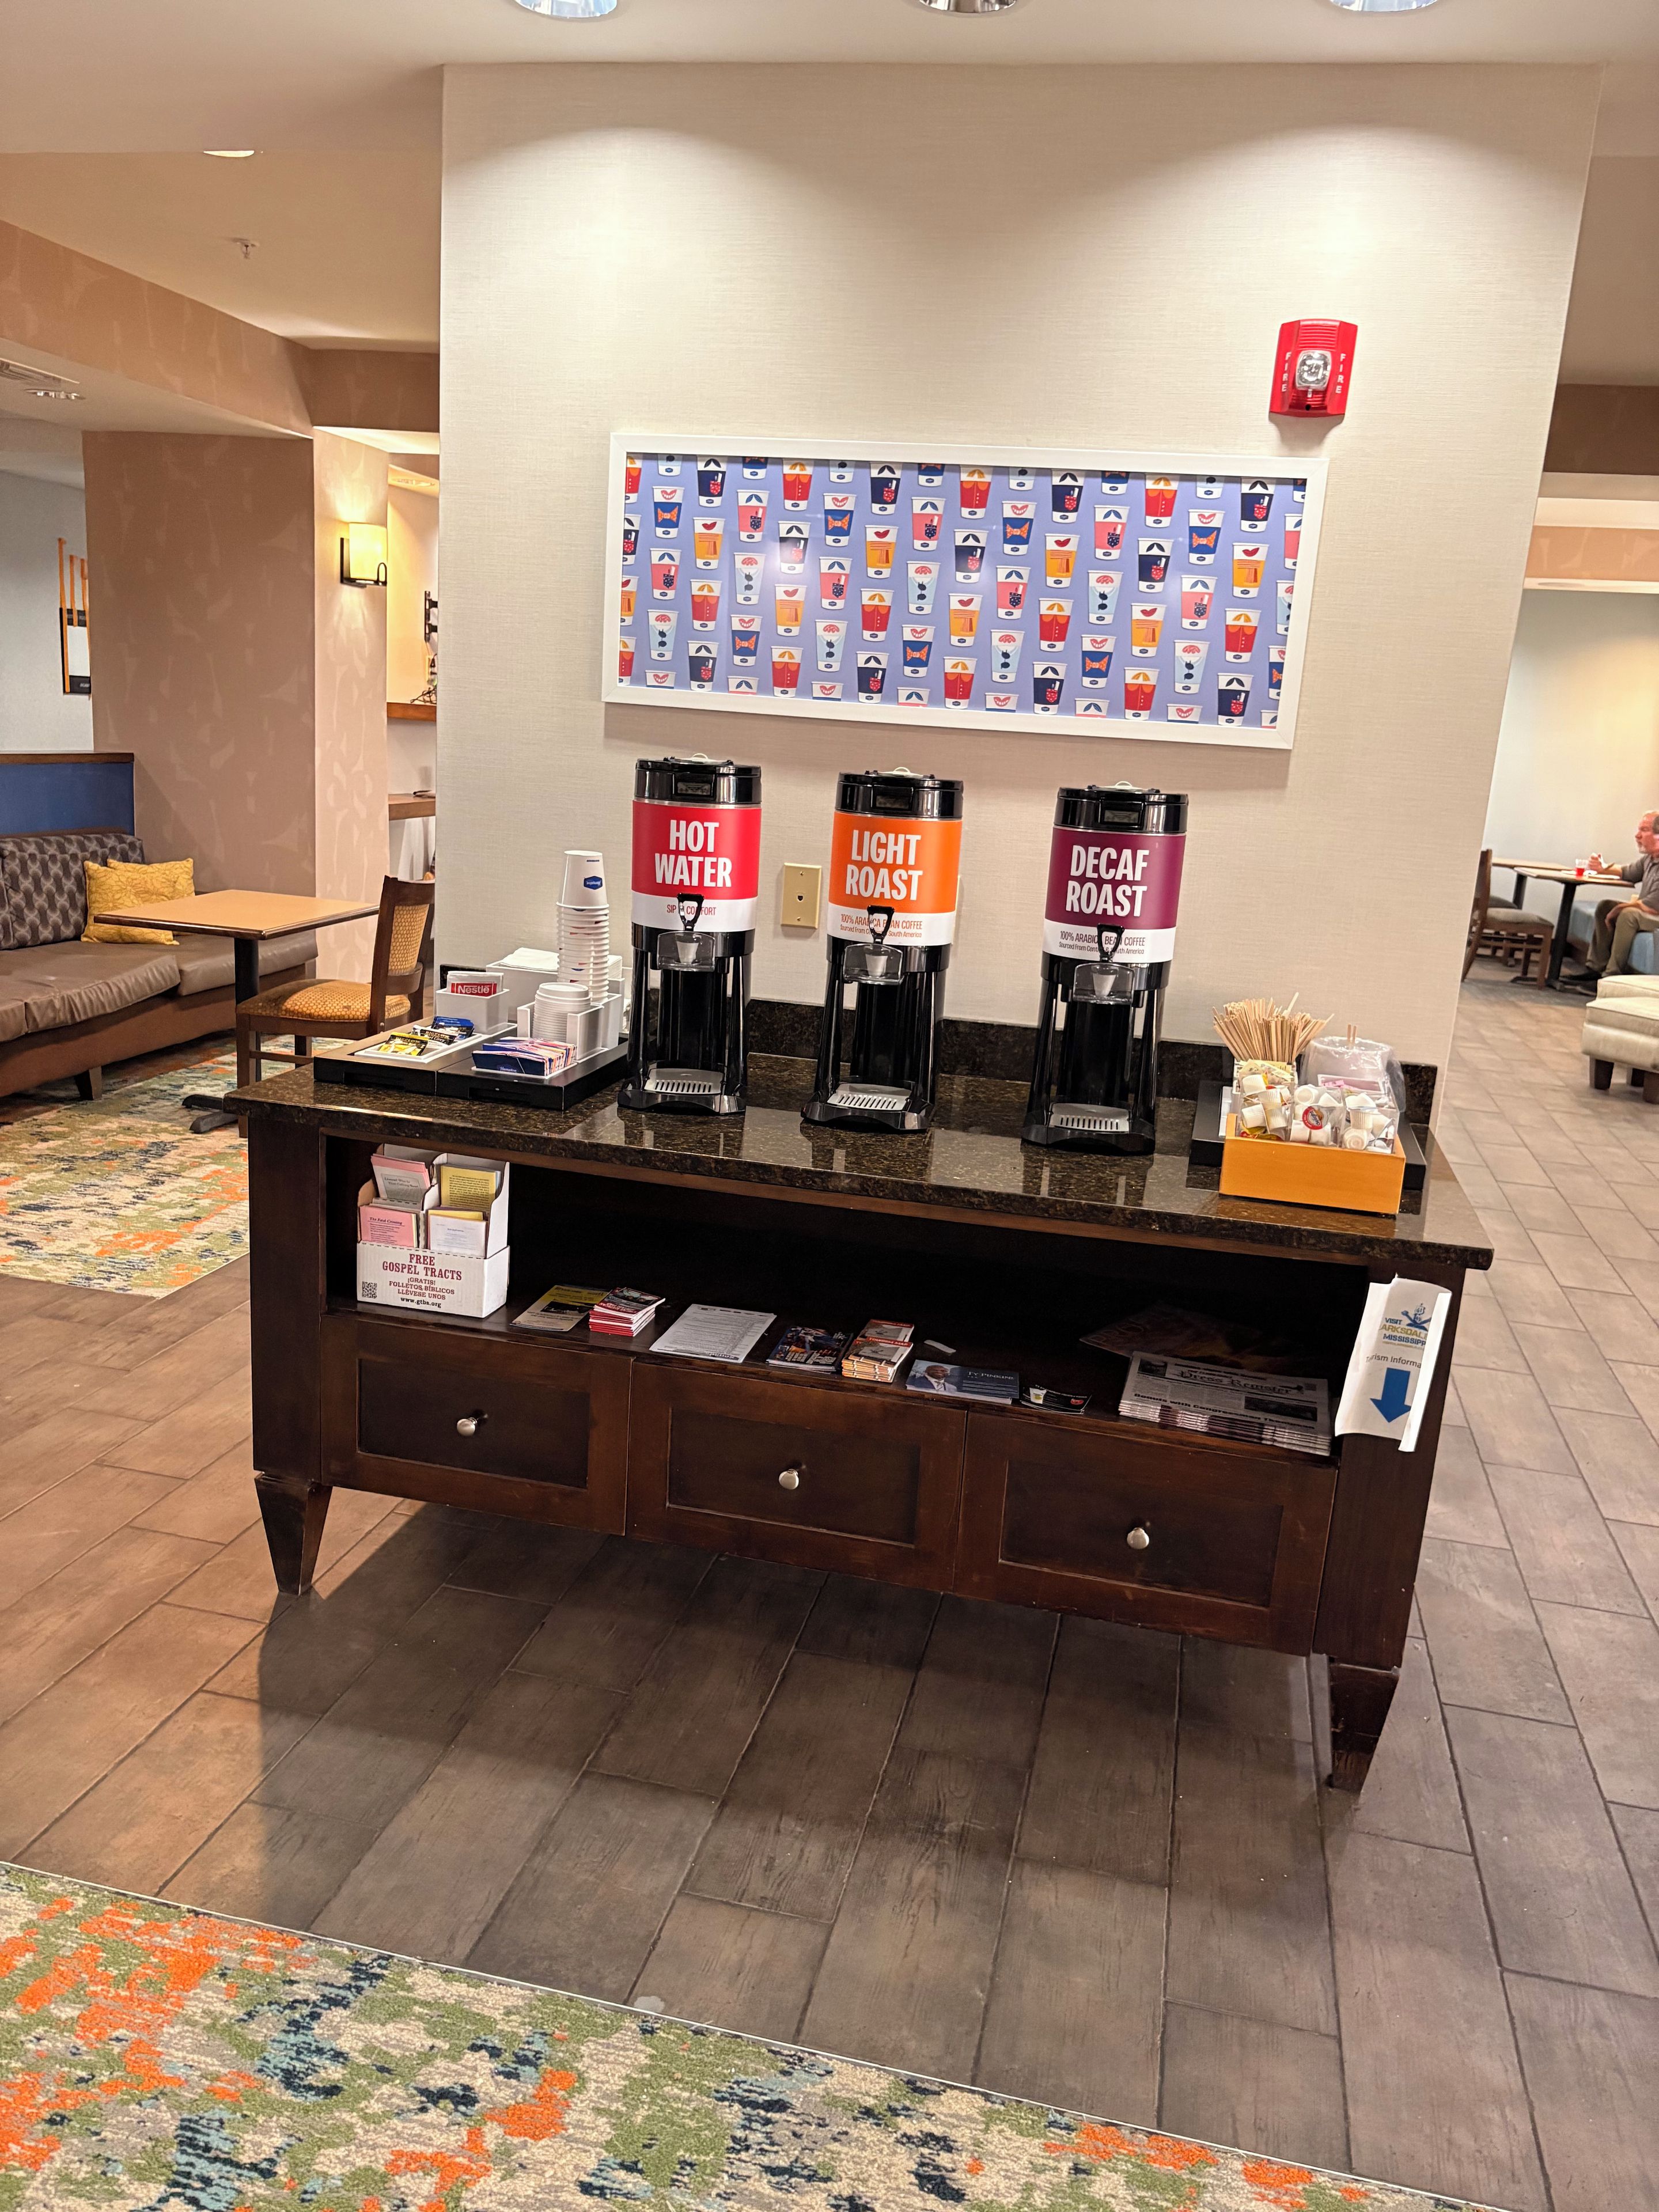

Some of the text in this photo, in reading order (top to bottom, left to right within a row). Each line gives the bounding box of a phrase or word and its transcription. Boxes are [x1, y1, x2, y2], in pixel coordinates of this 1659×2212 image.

[1281, 351, 1292, 392] FIRE
[1335, 353, 1346, 393] FIRE
[669, 819, 719, 853] HOT
[851, 830, 922, 865] LIGHT
[654, 853, 732, 888] WATER
[1070, 845, 1149, 881] DECAF
[845, 864, 923, 900] ROAST
[1066, 881, 1147, 917] ROAST
[666, 904, 677, 913] SIP
[686, 906, 717, 915] COFORT
[841, 914, 922, 930] 100% ARABCA BAN COFFEE
[1059, 941, 1074, 950] Sourced
[1060, 930, 1146, 946] 100% ARABIC BEA COFFEE
[382, 1261, 462, 1281] GOSPEL TRACTS
[409, 1253, 435, 1266] FREE
[397, 1288, 426, 1298] LLÉVESE
